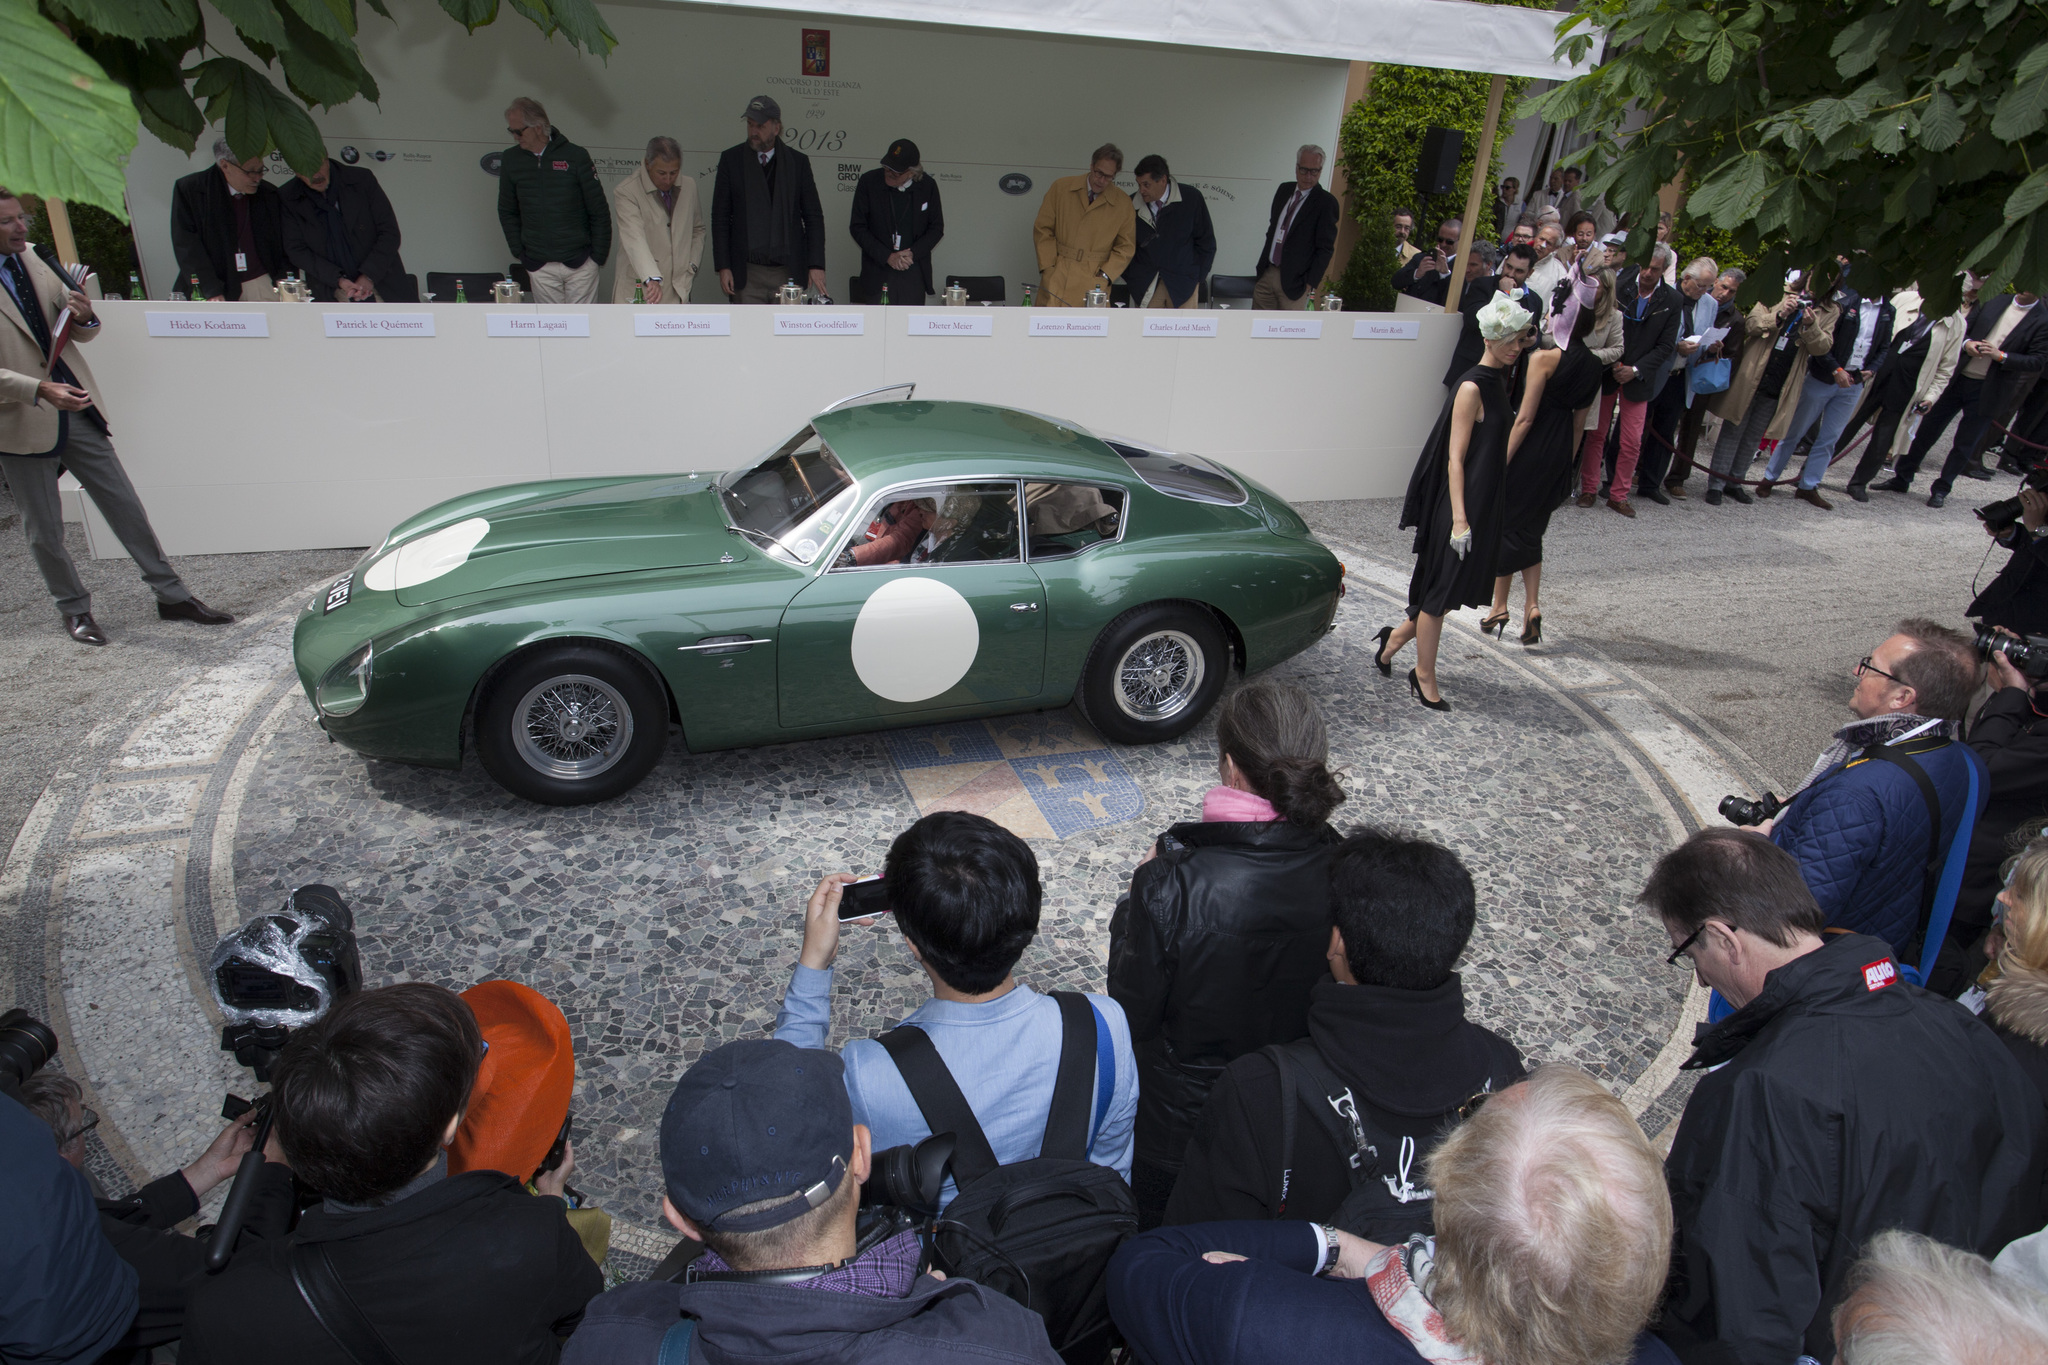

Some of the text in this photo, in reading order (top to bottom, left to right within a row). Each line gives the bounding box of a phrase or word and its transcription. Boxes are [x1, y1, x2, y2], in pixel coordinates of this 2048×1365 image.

[766, 76, 862, 89] CONCORSO D'ELEGANZA
[783, 127, 846, 152] 2013
[838, 164, 862, 172] BMW
[170, 320, 246, 330] Hideo Kodama
[336, 320, 423, 330] Patrick le Quément
[510, 320, 568, 330] Harm Lagaaij
[654, 321, 710, 329] Stefano Pasini
[814, 320, 858, 329] Goodfellow
[1281, 1169, 1292, 1201] LUMIX
